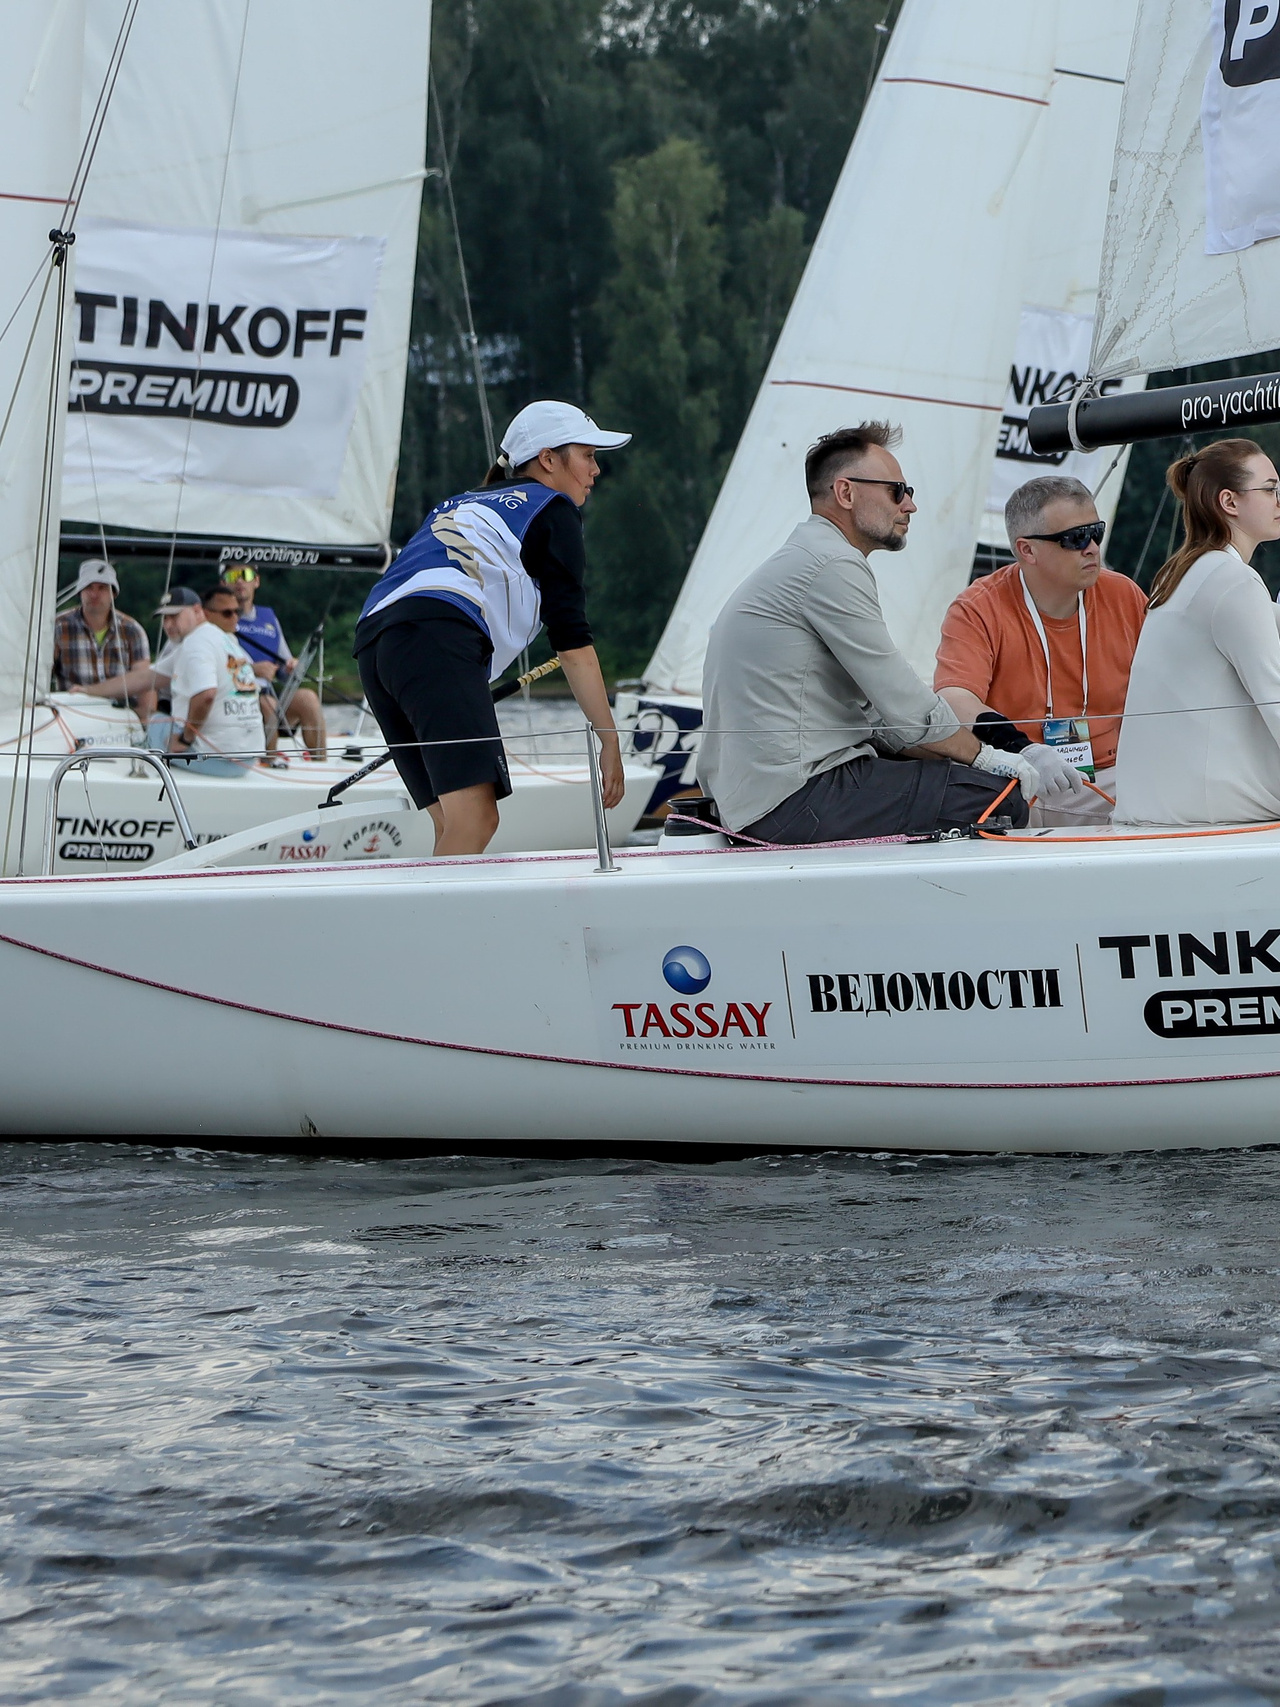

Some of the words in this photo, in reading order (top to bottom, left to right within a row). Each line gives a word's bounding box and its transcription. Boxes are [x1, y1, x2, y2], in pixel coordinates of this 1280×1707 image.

[74, 290, 367, 358] TINKOFF
[69, 369, 288, 418] PREMIUM
[219, 545, 319, 566] pro-yachting.ru
[57, 817, 175, 838] TINKOFF
[64, 843, 150, 859] PREMIUM
[279, 845, 331, 860] TASSAY
[806, 968, 1064, 1018] ВЕДОМОСТИ
[611, 1002, 773, 1038] TASSAY
